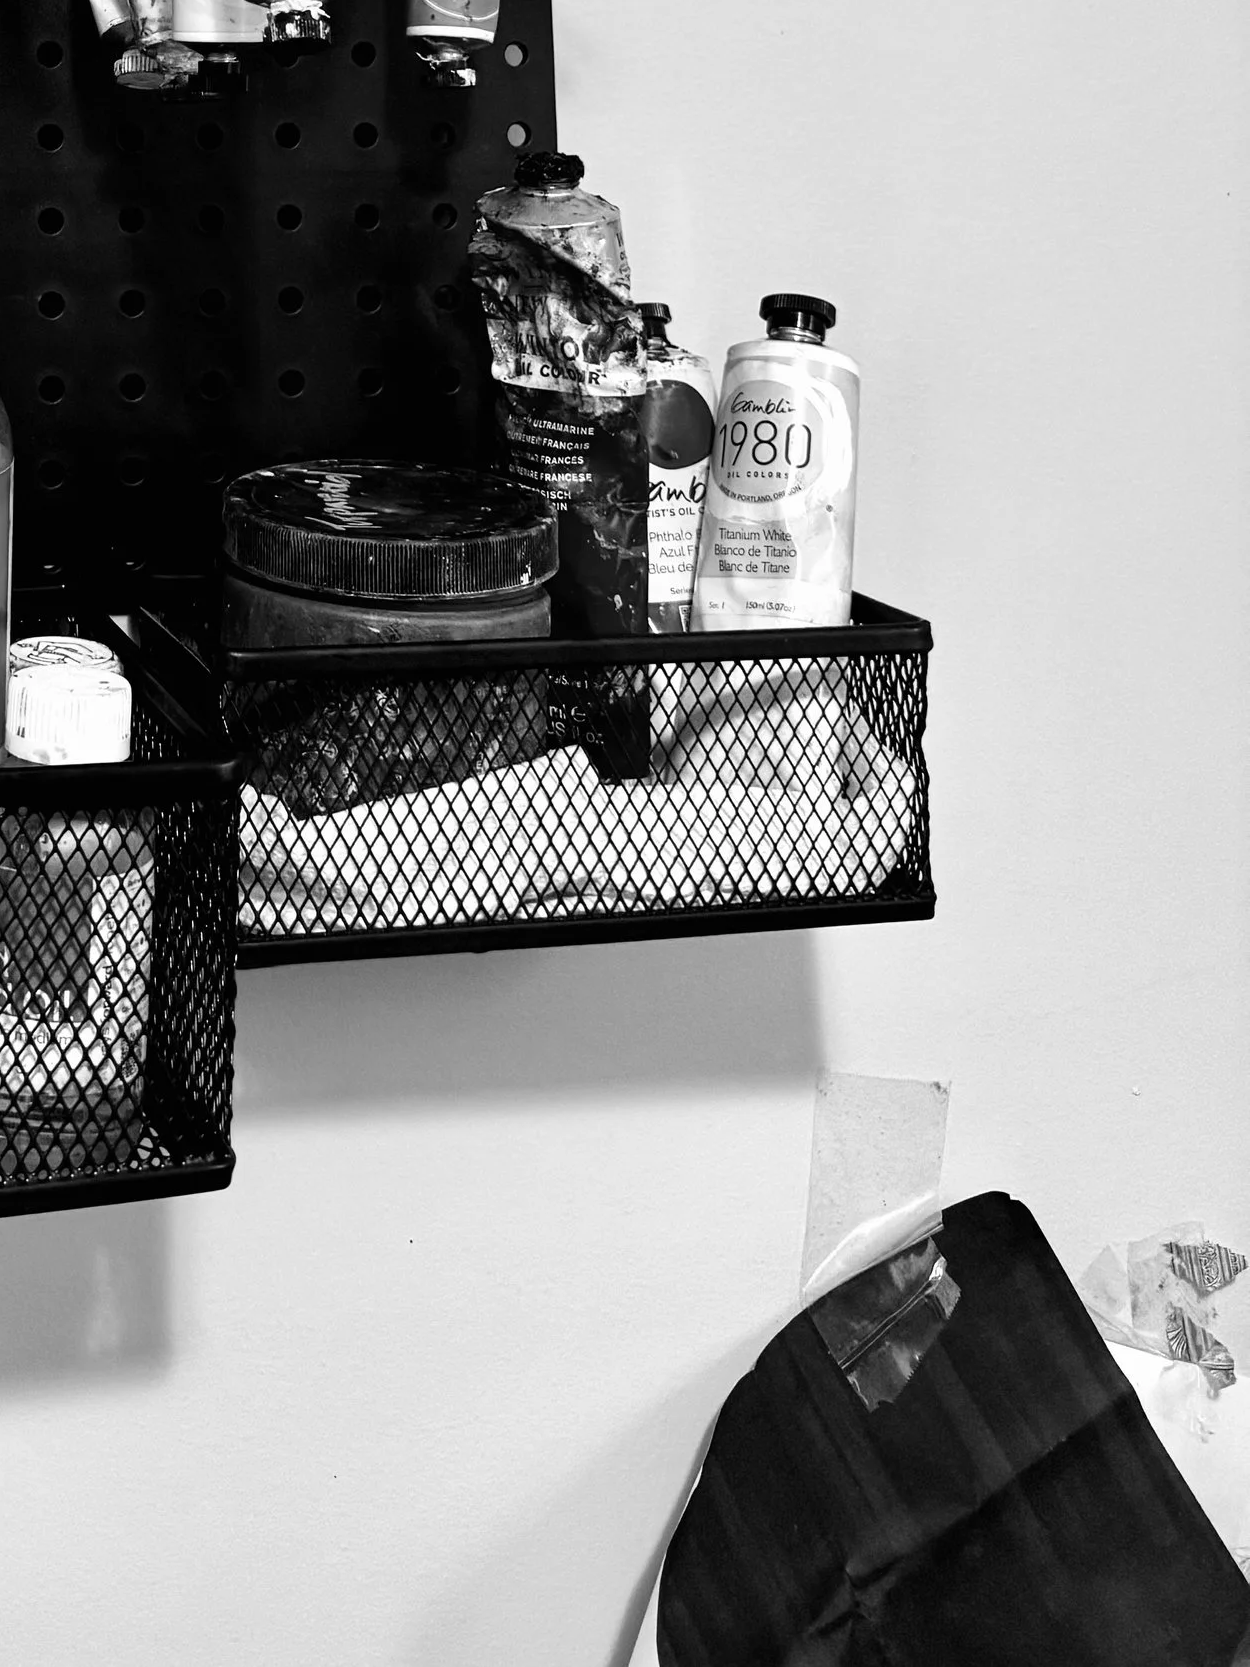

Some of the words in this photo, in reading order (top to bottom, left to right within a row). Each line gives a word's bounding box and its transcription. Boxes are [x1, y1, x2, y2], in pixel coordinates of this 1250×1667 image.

[718, 419, 812, 469] 1980
[540, 471, 593, 483] FRANCESE
[746, 470, 789, 479] COLORS
[678, 506, 696, 516] OIL
[649, 528, 693, 543] Phthalo
[718, 526, 761, 542] Titanium
[762, 528, 792, 543] White
[659, 546, 686, 559] Azul
[713, 543, 746, 558] Blanco
[747, 545, 762, 558] de
[763, 545, 798, 559] Titanio
[677, 561, 694, 573] de
[717, 559, 744, 574] Blanc
[745, 560, 759, 574] de
[760, 560, 791, 575] Titane
